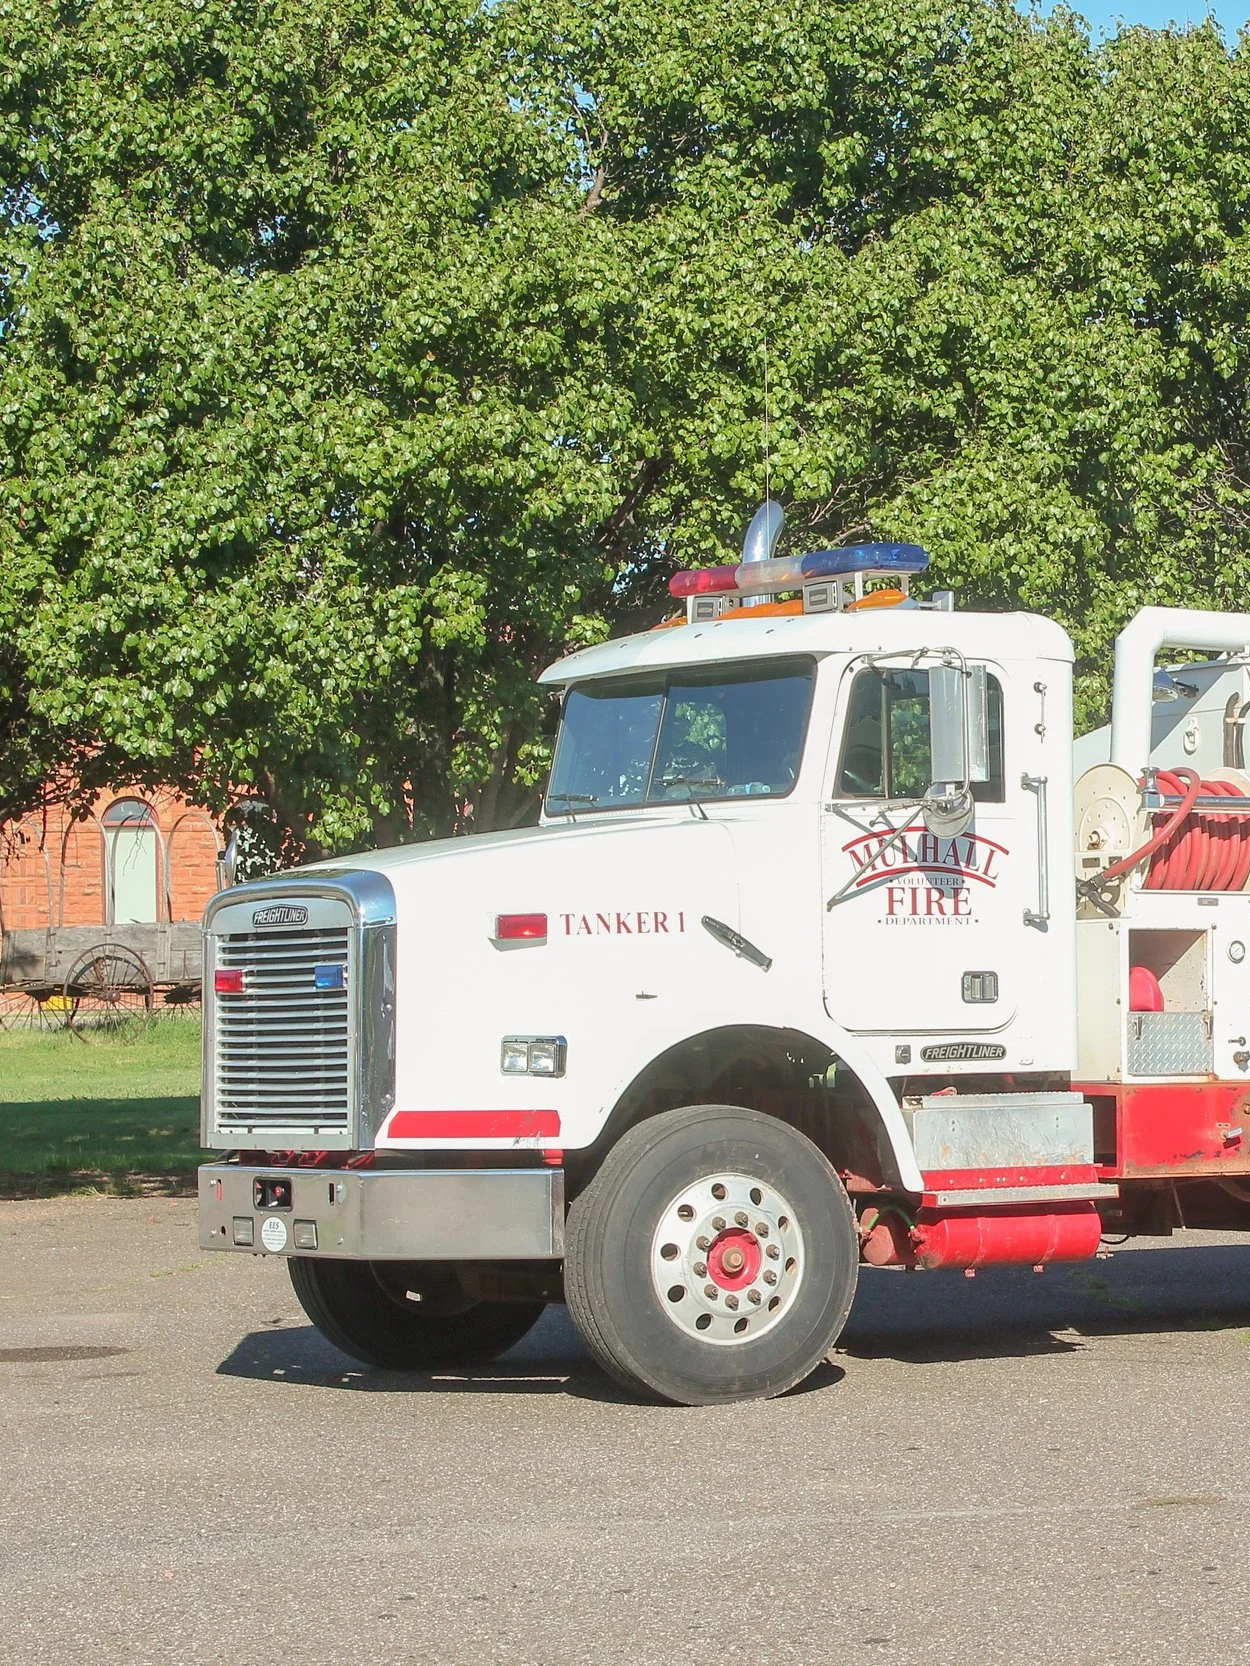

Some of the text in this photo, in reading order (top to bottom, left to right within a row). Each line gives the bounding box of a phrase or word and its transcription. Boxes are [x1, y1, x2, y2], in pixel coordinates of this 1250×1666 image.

[848, 834, 1000, 880] MULHALL
[896, 877, 959, 886] VOLUNTEER
[885, 886, 972, 916] FIRE
[253, 907, 306, 924] FREIGHTLINER
[559, 911, 685, 936] TANKER 1
[885, 917, 971, 926] DEPARTMENT
[925, 1044, 1004, 1059] FREIGHTLINER
